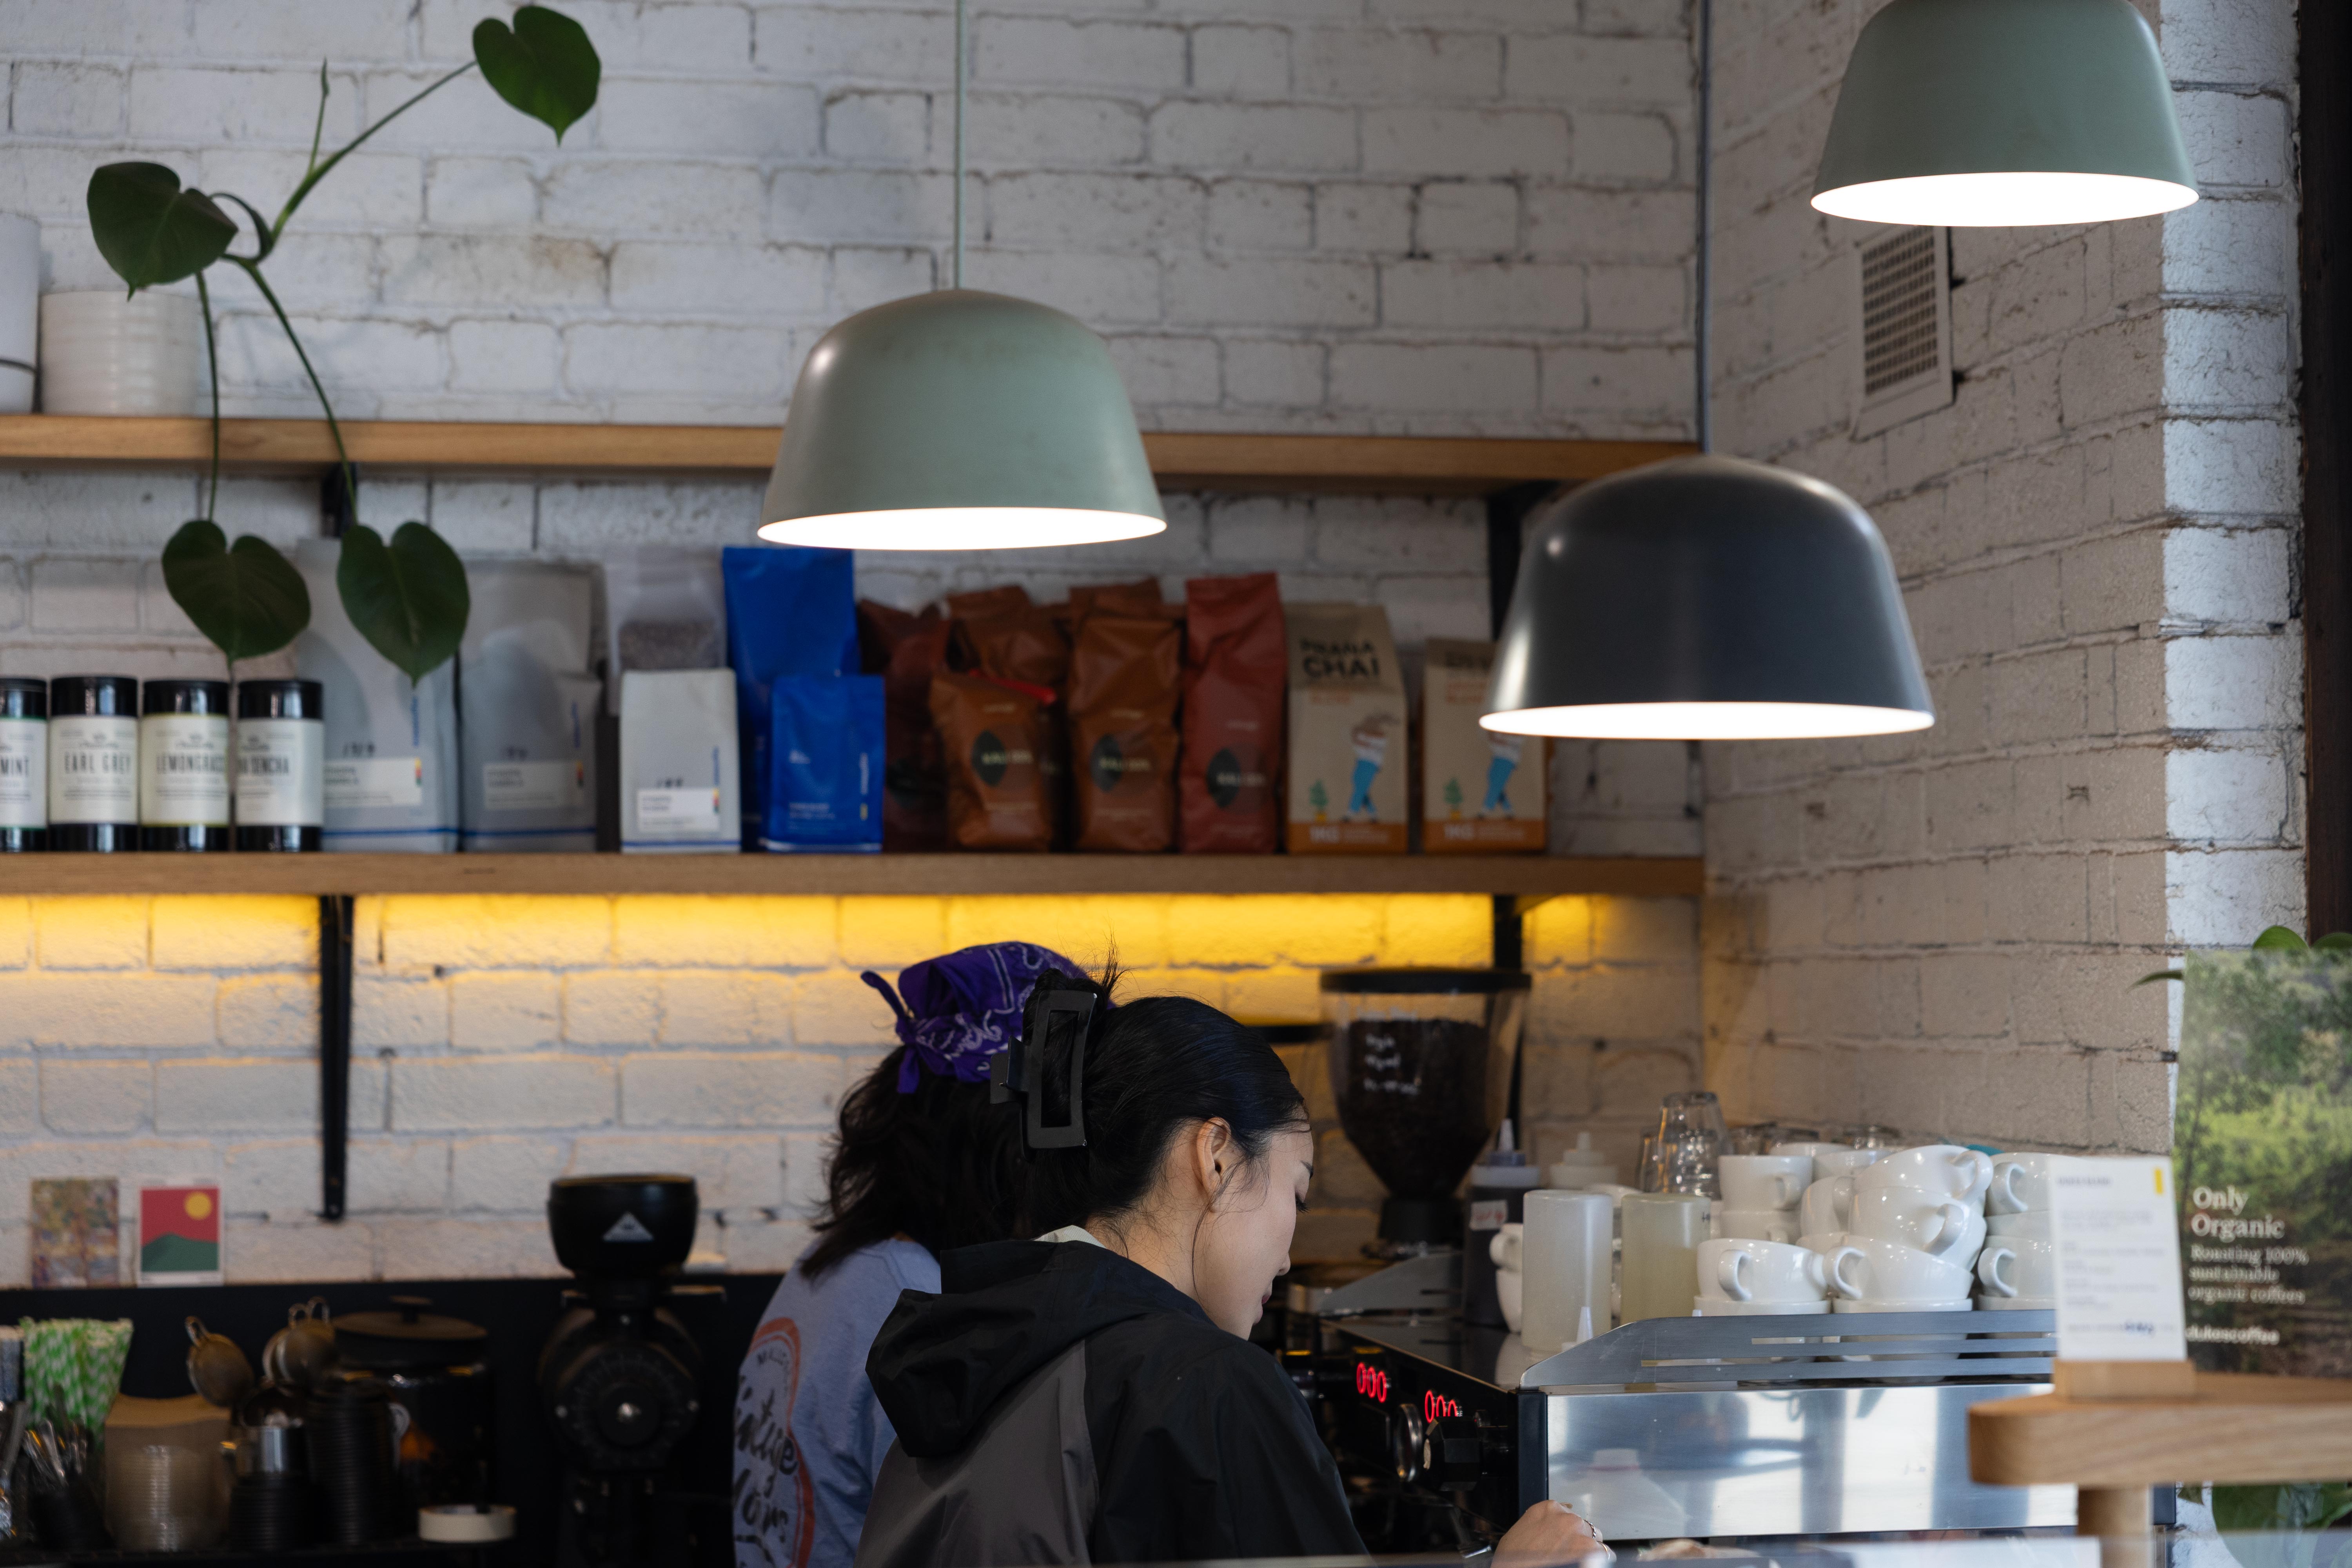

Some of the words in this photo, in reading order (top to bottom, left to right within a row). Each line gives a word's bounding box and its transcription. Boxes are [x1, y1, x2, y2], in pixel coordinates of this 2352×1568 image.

[1304, 657, 1379, 678] CHAI
[64, 753, 94, 774] EARL
[102, 753, 131, 774] GREY
[2193, 1185, 2249, 1216] Only
[2191, 1214, 2285, 1243] Organic
[2191, 1244, 2263, 1267] Roasting
[2265, 1246, 2309, 1266] 100%
[2189, 1264, 2280, 1284] sustainable
[2188, 1285, 2249, 1305] organic
[2250, 1284, 2306, 1305] coffees
[1356, 1362, 1387, 1403] 000
